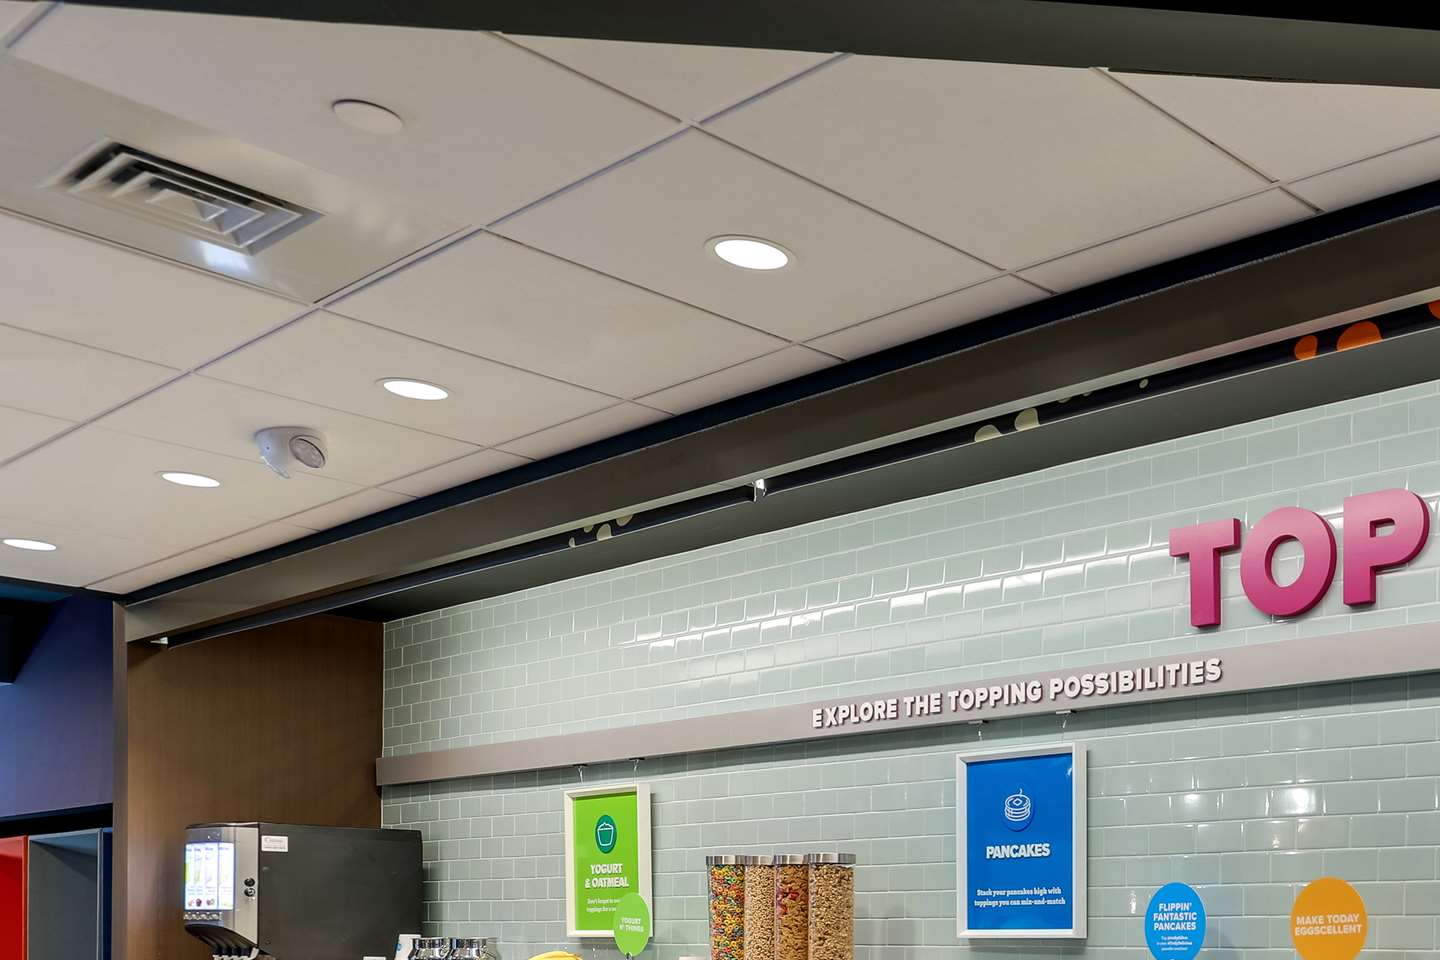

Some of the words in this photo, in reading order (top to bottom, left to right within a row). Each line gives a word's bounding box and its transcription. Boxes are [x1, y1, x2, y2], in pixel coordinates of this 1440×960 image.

[1169, 488, 1430, 627] TOP
[812, 698, 898, 728] EXPLORE
[904, 692, 943, 718] THE
[948, 680, 1043, 712] TOPPING
[1049, 658, 1223, 700] POSSIBILITIES
[986, 843, 1051, 859] PANCAKES
[590, 863, 623, 875] YOGURT
[584, 878, 591, 889] &
[592, 877, 629, 888] OATMEAL
[1006, 888, 1033, 897] pancakes
[1048, 886, 1062, 895] with
[1158, 902, 1192, 912] FLIPPIN'
[1153, 912, 1197, 921] FANTASTIC
[1296, 916, 1325, 925] MAKE
[1327, 913, 1360, 924] TODAY
[1154, 922, 1197, 931] PANCAKES
[1295, 924, 1362, 936] EGGSCELLENT
